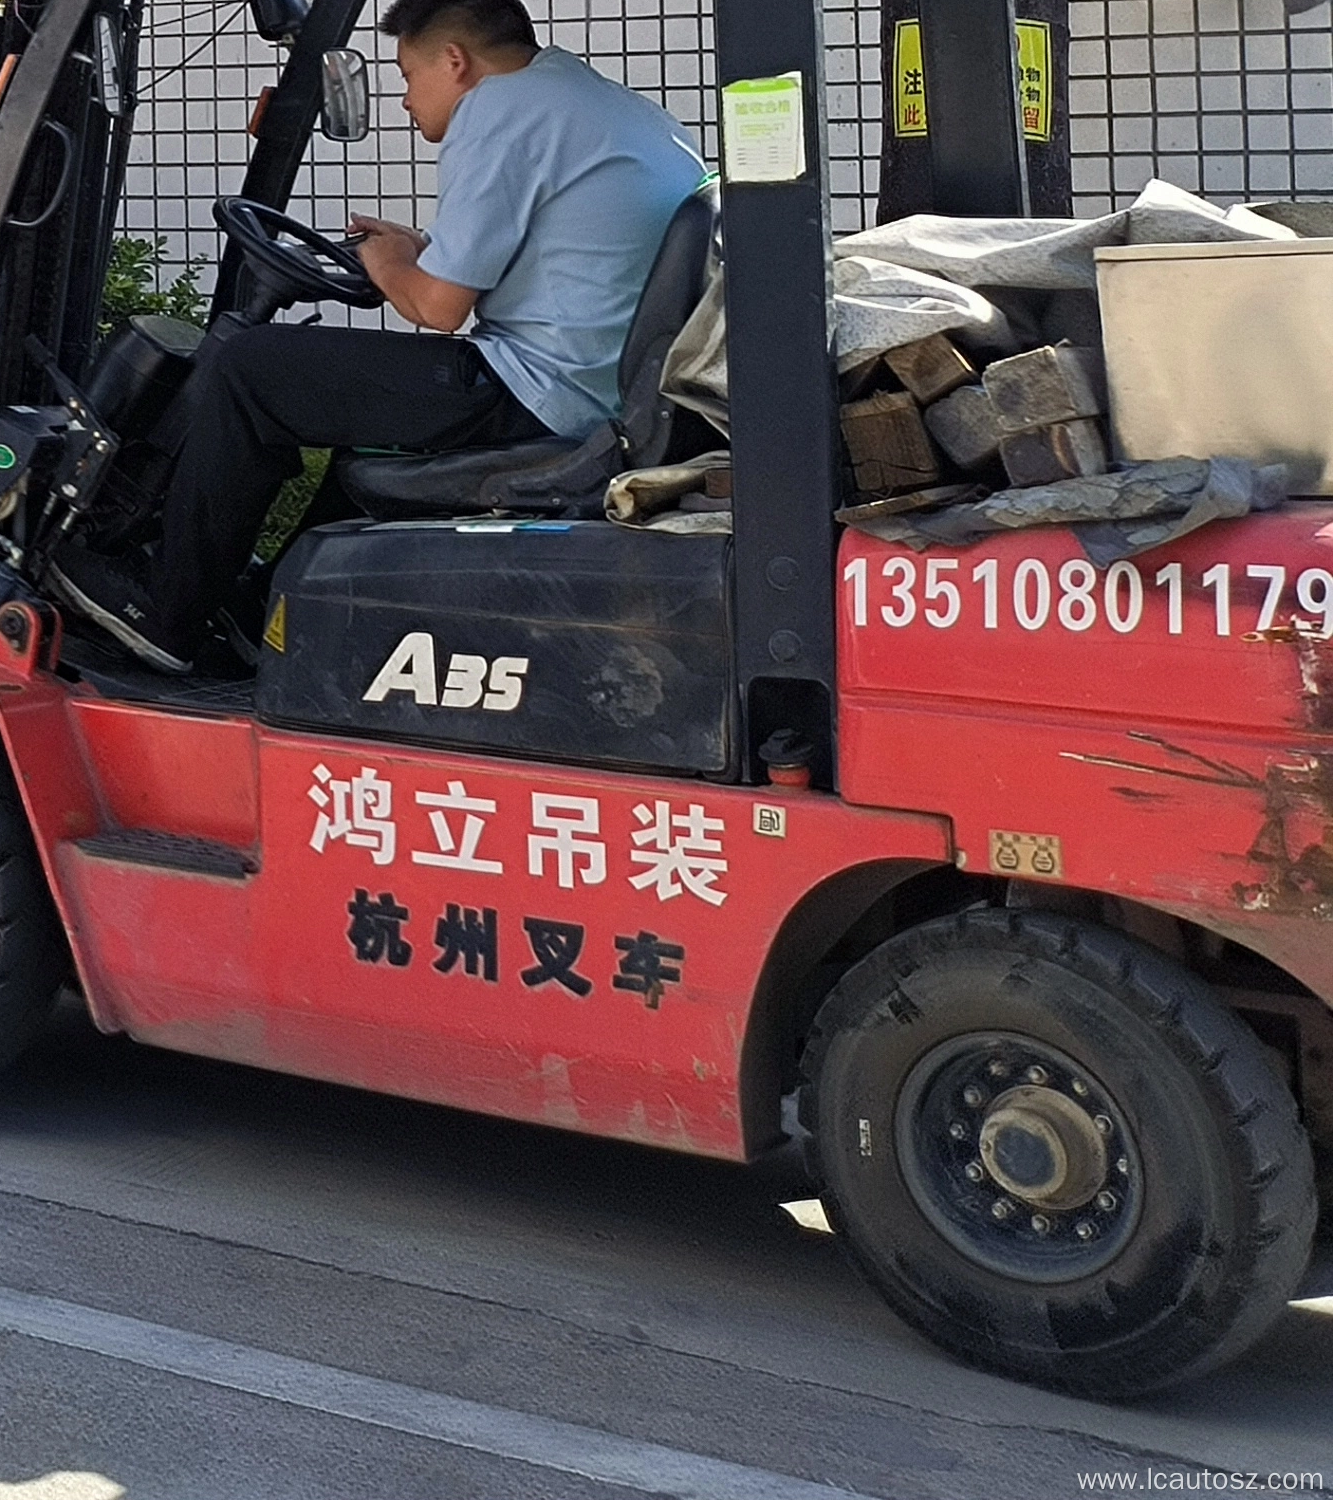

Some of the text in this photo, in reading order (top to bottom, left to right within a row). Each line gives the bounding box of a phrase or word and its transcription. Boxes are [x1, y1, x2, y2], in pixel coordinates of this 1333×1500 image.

[843, 556, 1333, 640] 13510801179
[306, 762, 731, 906] 鸿立吊装
[346, 888, 686, 1008] 杭州叉车
